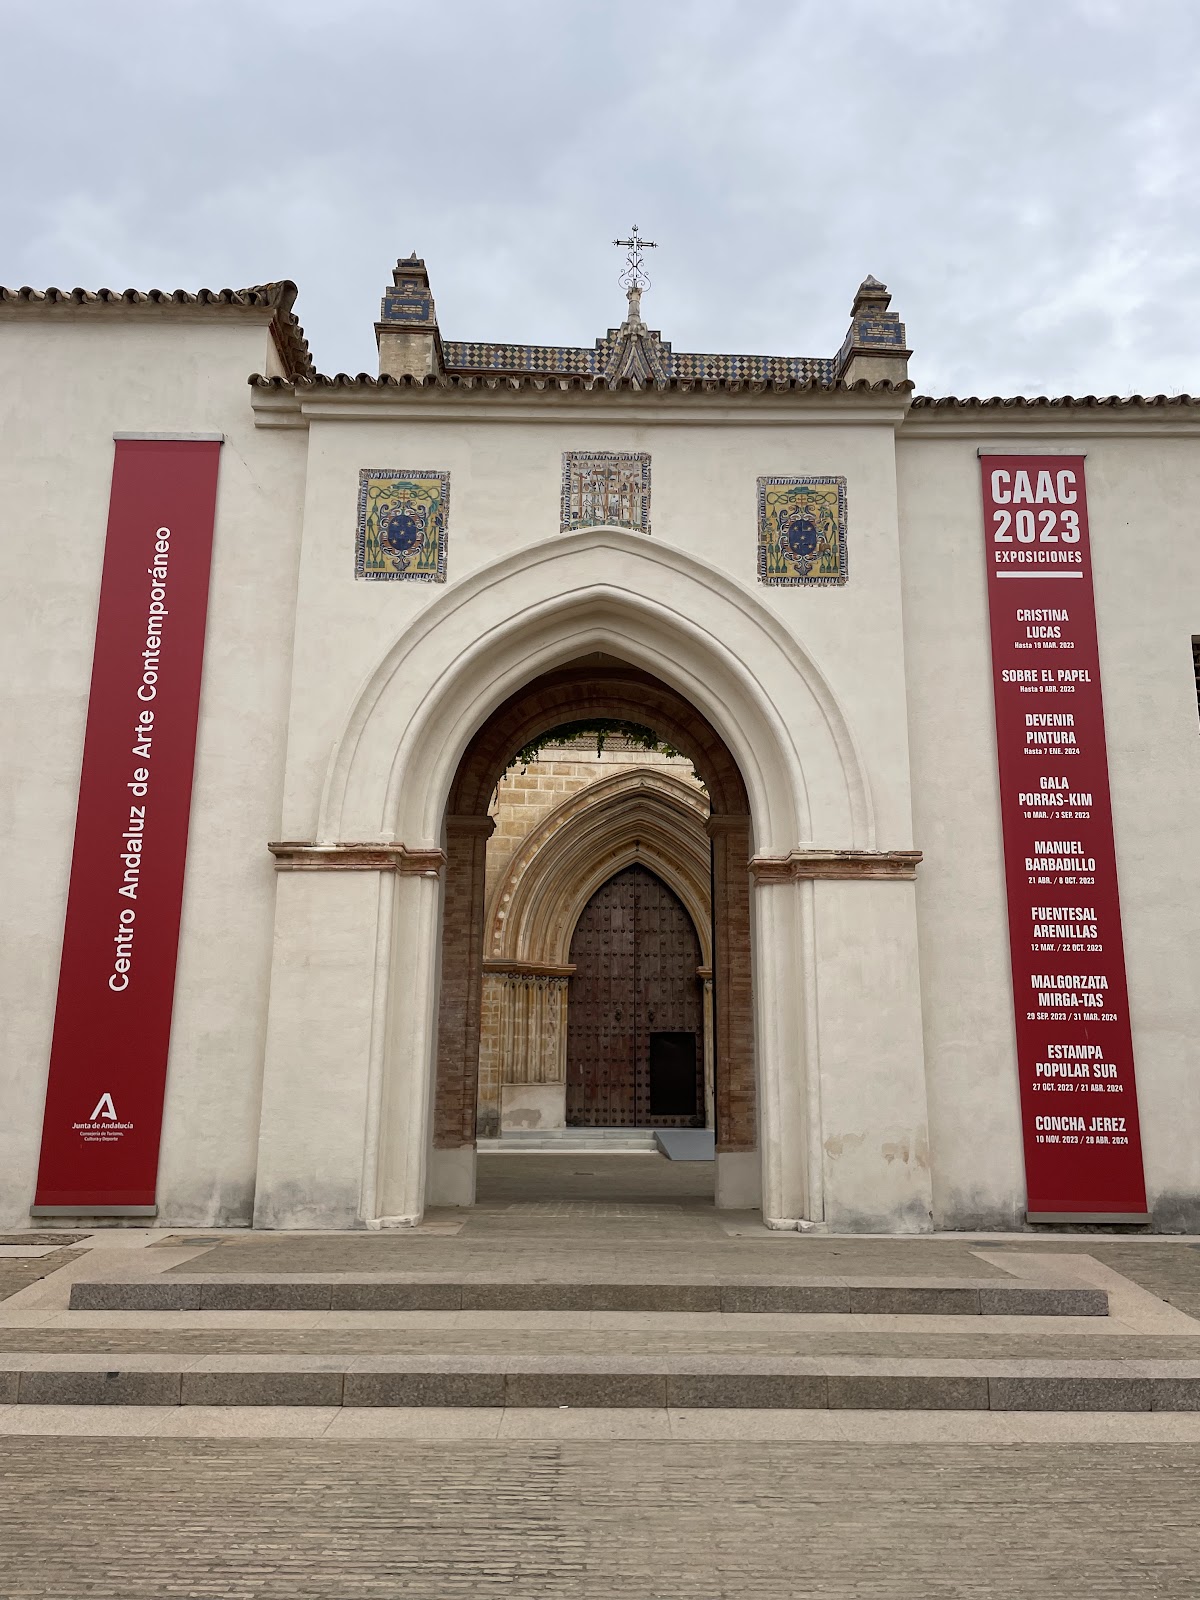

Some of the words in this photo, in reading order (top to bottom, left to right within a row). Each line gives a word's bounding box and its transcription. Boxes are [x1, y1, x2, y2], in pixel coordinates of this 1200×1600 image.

[991, 470, 1077, 504] CAAC
[993, 510, 1080, 543] 2023
[995, 551, 1082, 563] EXPOSICIONES
[138, 527, 170, 701] Contemporáneo
[1017, 609, 1069, 621] CRISTINA
[1027, 626, 1061, 638] LUCAS
[1002, 670, 1038, 682] SOBRE
[1041, 670, 1054, 681] EL
[1058, 670, 1091, 682] PAPEL
[1026, 714, 1074, 726] DEVENIR
[132, 711, 154, 758] Arte
[1026, 732, 1076, 744] PINTURA
[127, 768, 149, 796] de
[1040, 777, 1069, 789] GALA
[1019, 793, 1092, 806] PORRAS-KIM
[119, 806, 145, 899] Andaluz
[1035, 841, 1084, 854] MANUEL
[1025, 858, 1095, 871] BARBADILLO
[1038, 877, 1052, 885] ABR.
[1065, 877, 1077, 885] OCT.
[1079, 877, 1094, 885] 2023
[1032, 907, 1097, 920] FUENTESAL
[1034, 925, 1097, 938] ARENILLAS
[109, 909, 135, 991] Centro
[1031, 944, 1039, 952] 12
[1041, 944, 1055, 952] MAY.
[1063, 944, 1070, 952] 22
[1072, 944, 1085, 952] OCT.
[1087, 944, 1102, 952] 2023
[1031, 975, 1108, 989] MALGORZATA
[1039, 993, 1103, 1007] MIRGA-TAS
[1037, 1013, 1049, 1021] SEP.
[1051, 1013, 1066, 1021] 2023
[1074, 1013, 1081, 1021] 31
[1083, 1013, 1100, 1021] MAR.
[1101, 1014, 1117, 1022] 2024
[1048, 1045, 1103, 1059] ESTAMPA
[1036, 1063, 1090, 1077] POPULAR
[1093, 1064, 1117, 1078] SUR
[1033, 1083, 1040, 1091] 27
[1043, 1083, 1056, 1091] OCT.
[1057, 1084, 1073, 1092] 2023
[1081, 1084, 1088, 1092] 21
[1091, 1084, 1105, 1092] ABR.
[1107, 1085, 1123, 1093] 2024
[1036, 1116, 1086, 1131] CONCHA
[1089, 1117, 1126, 1131] JEREZ
[1036, 1135, 1044, 1143] 10
[1046, 1135, 1061, 1143] NOV.
[1062, 1136, 1078, 1144] 2023
[1086, 1136, 1094, 1144] 28
[1096, 1136, 1110, 1144] ABR.
[1112, 1137, 1128, 1145] 2024
